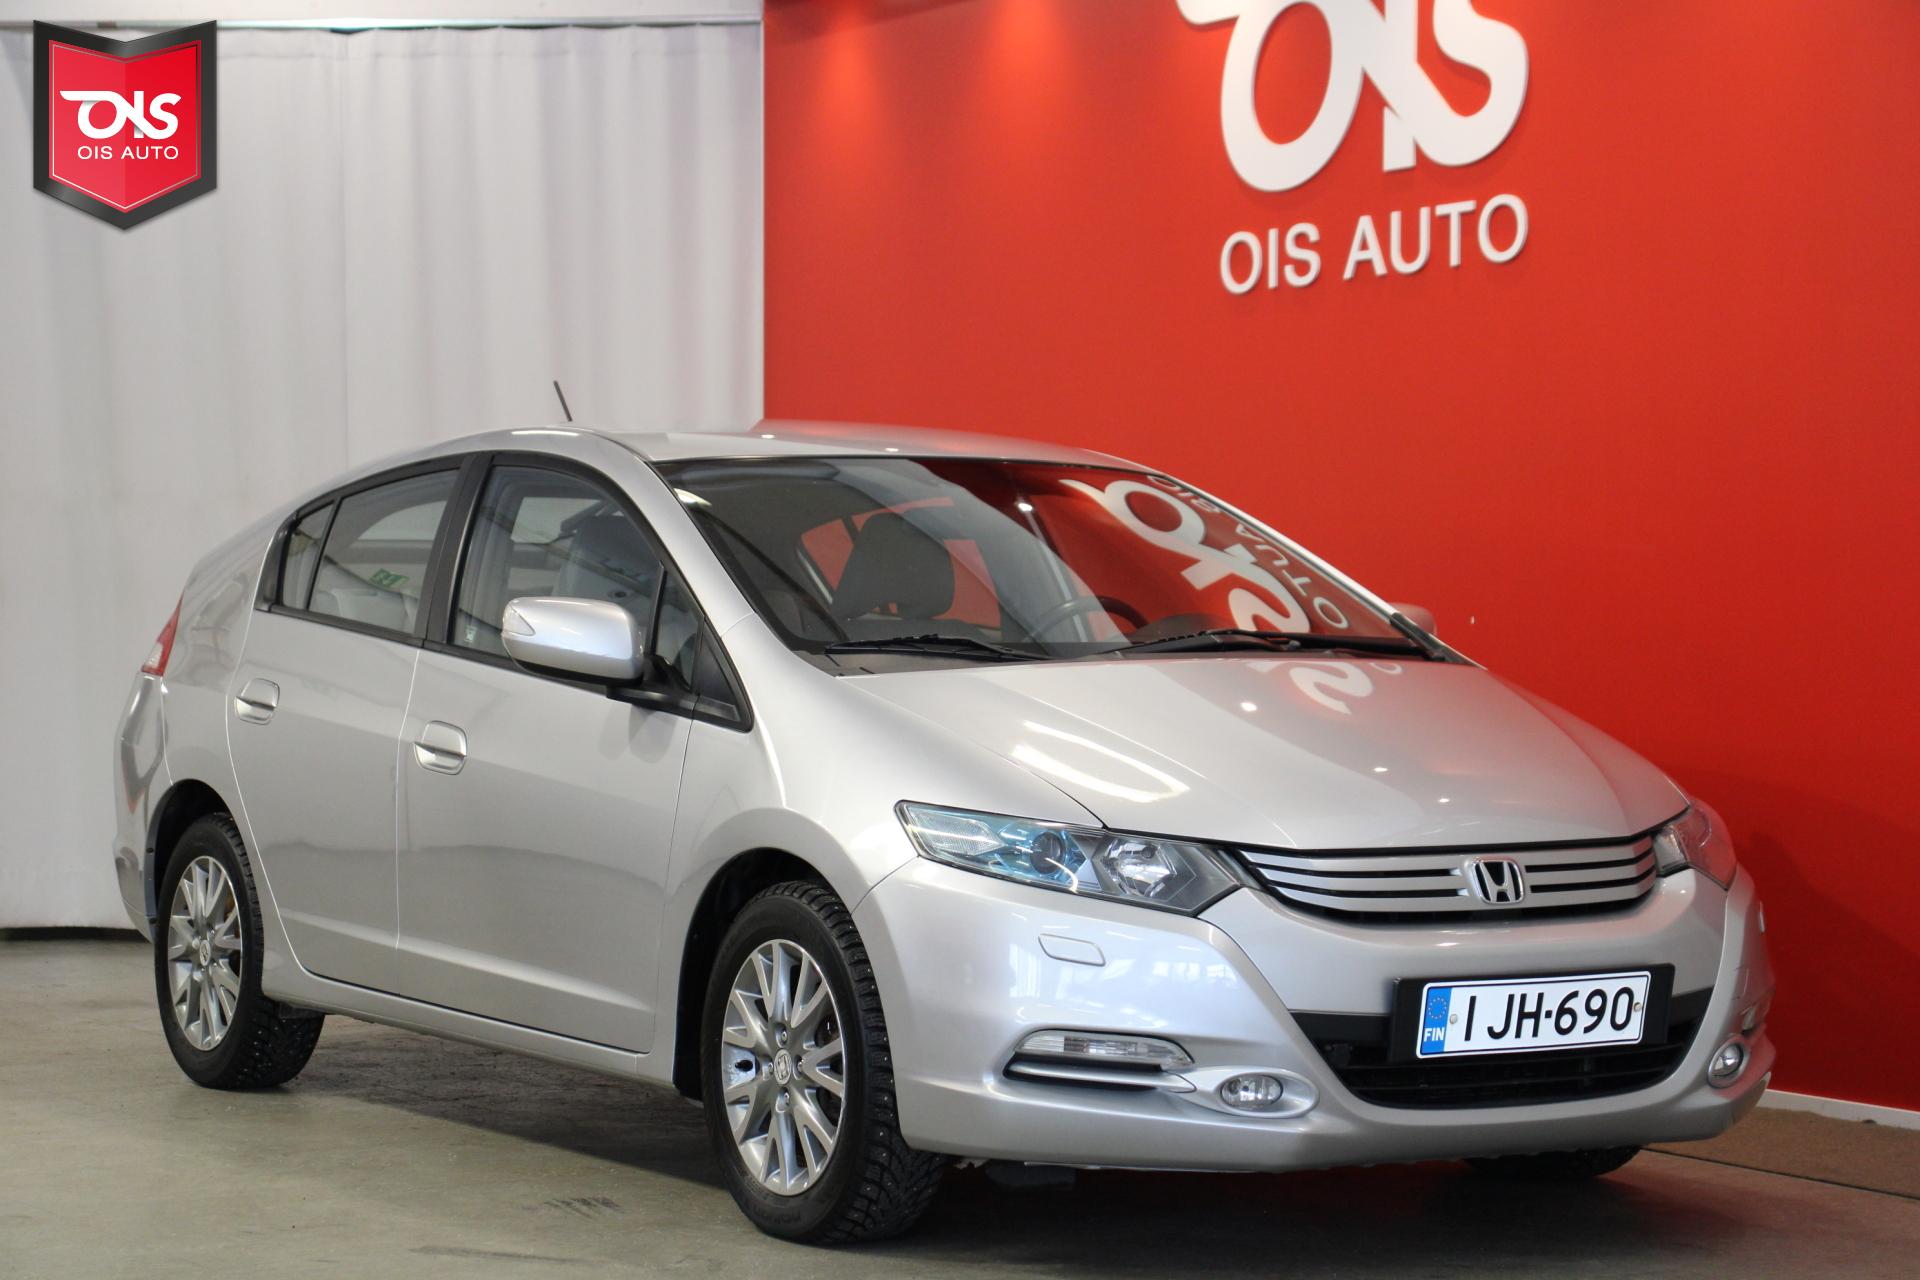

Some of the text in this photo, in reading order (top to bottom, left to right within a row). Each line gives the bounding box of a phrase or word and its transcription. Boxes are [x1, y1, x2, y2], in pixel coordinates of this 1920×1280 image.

[1175, 0, 1529, 192] OIS
[1220, 194, 1529, 294] OIS AUTO
[1423, 1027, 1445, 1043] FIN
